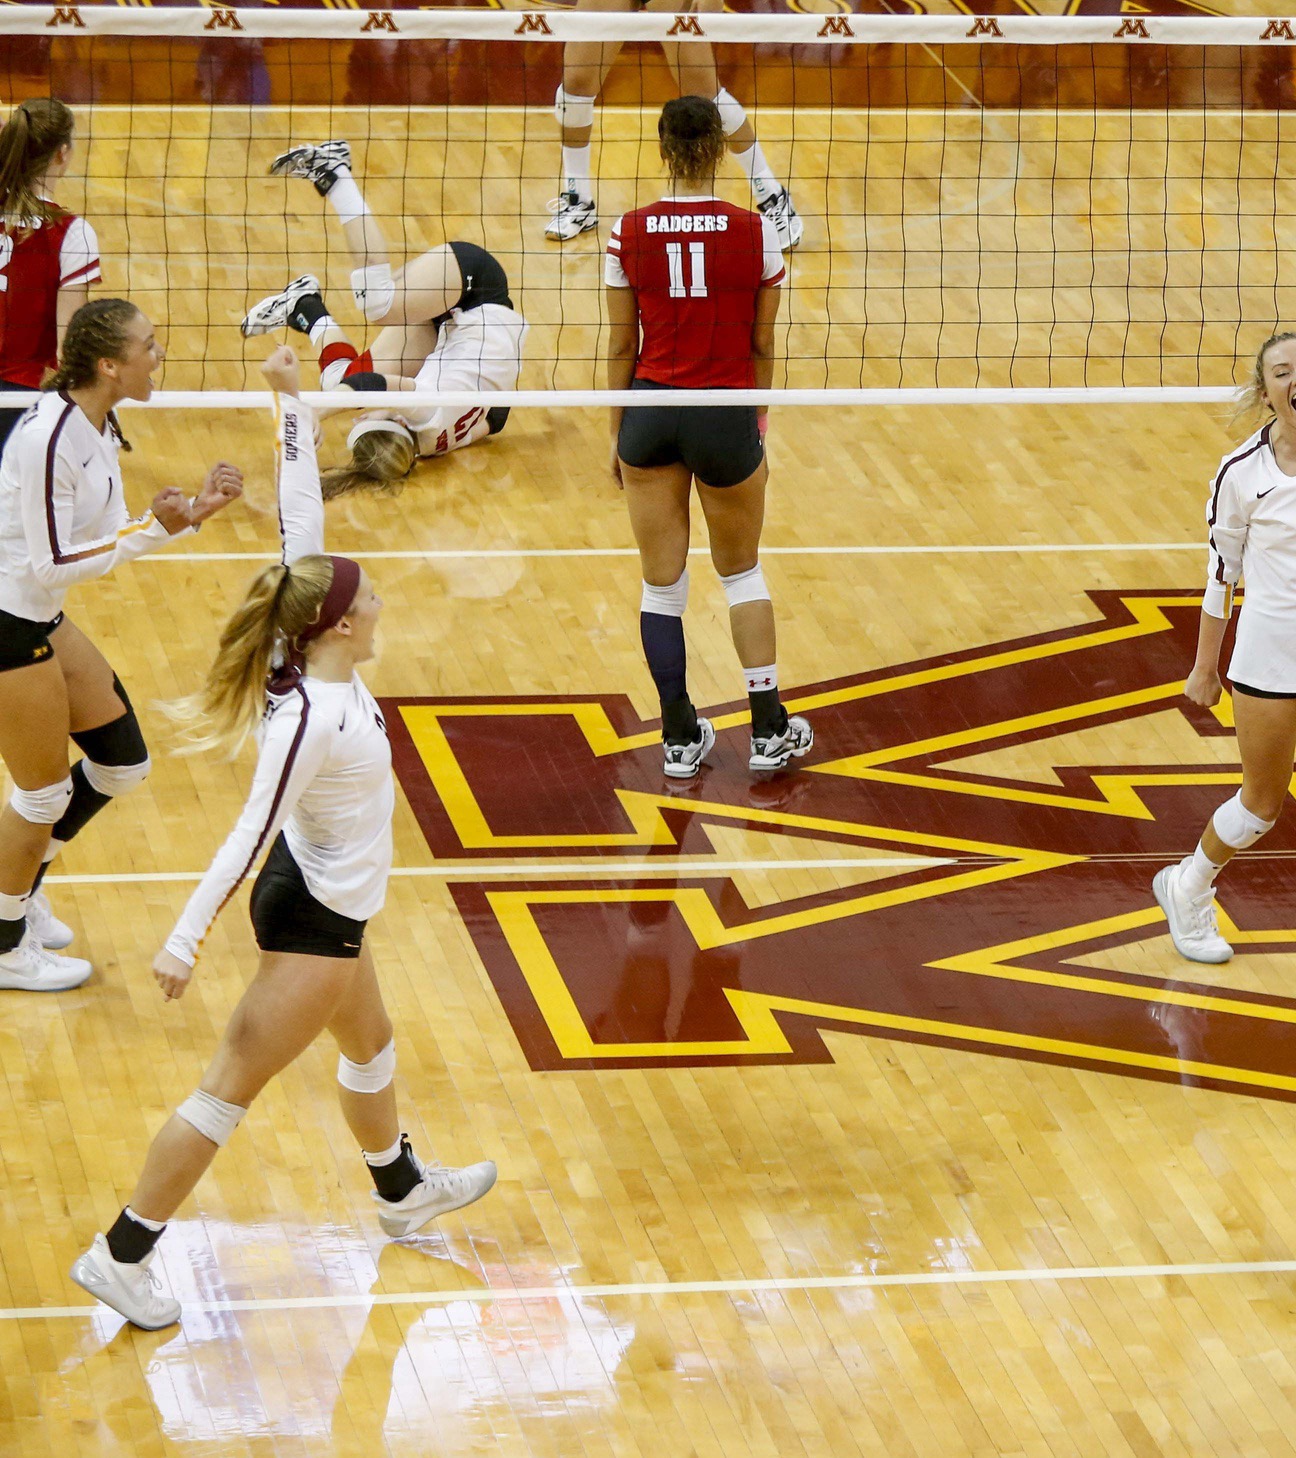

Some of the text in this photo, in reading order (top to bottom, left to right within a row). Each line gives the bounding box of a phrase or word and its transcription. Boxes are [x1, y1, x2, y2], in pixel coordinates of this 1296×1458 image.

[45, 8, 86, 28] M
[204, 10, 244, 31] M
[360, 13, 399, 33] M
[514, 14, 552, 35] M
[666, 15, 704, 36] M
[817, 16, 854, 37] M
[966, 18, 1003, 37] M
[1113, 18, 1150, 38] M
[1259, 20, 1296, 40] M
[646, 215, 729, 233] BADGERS
[665, 242, 708, 298] 11
